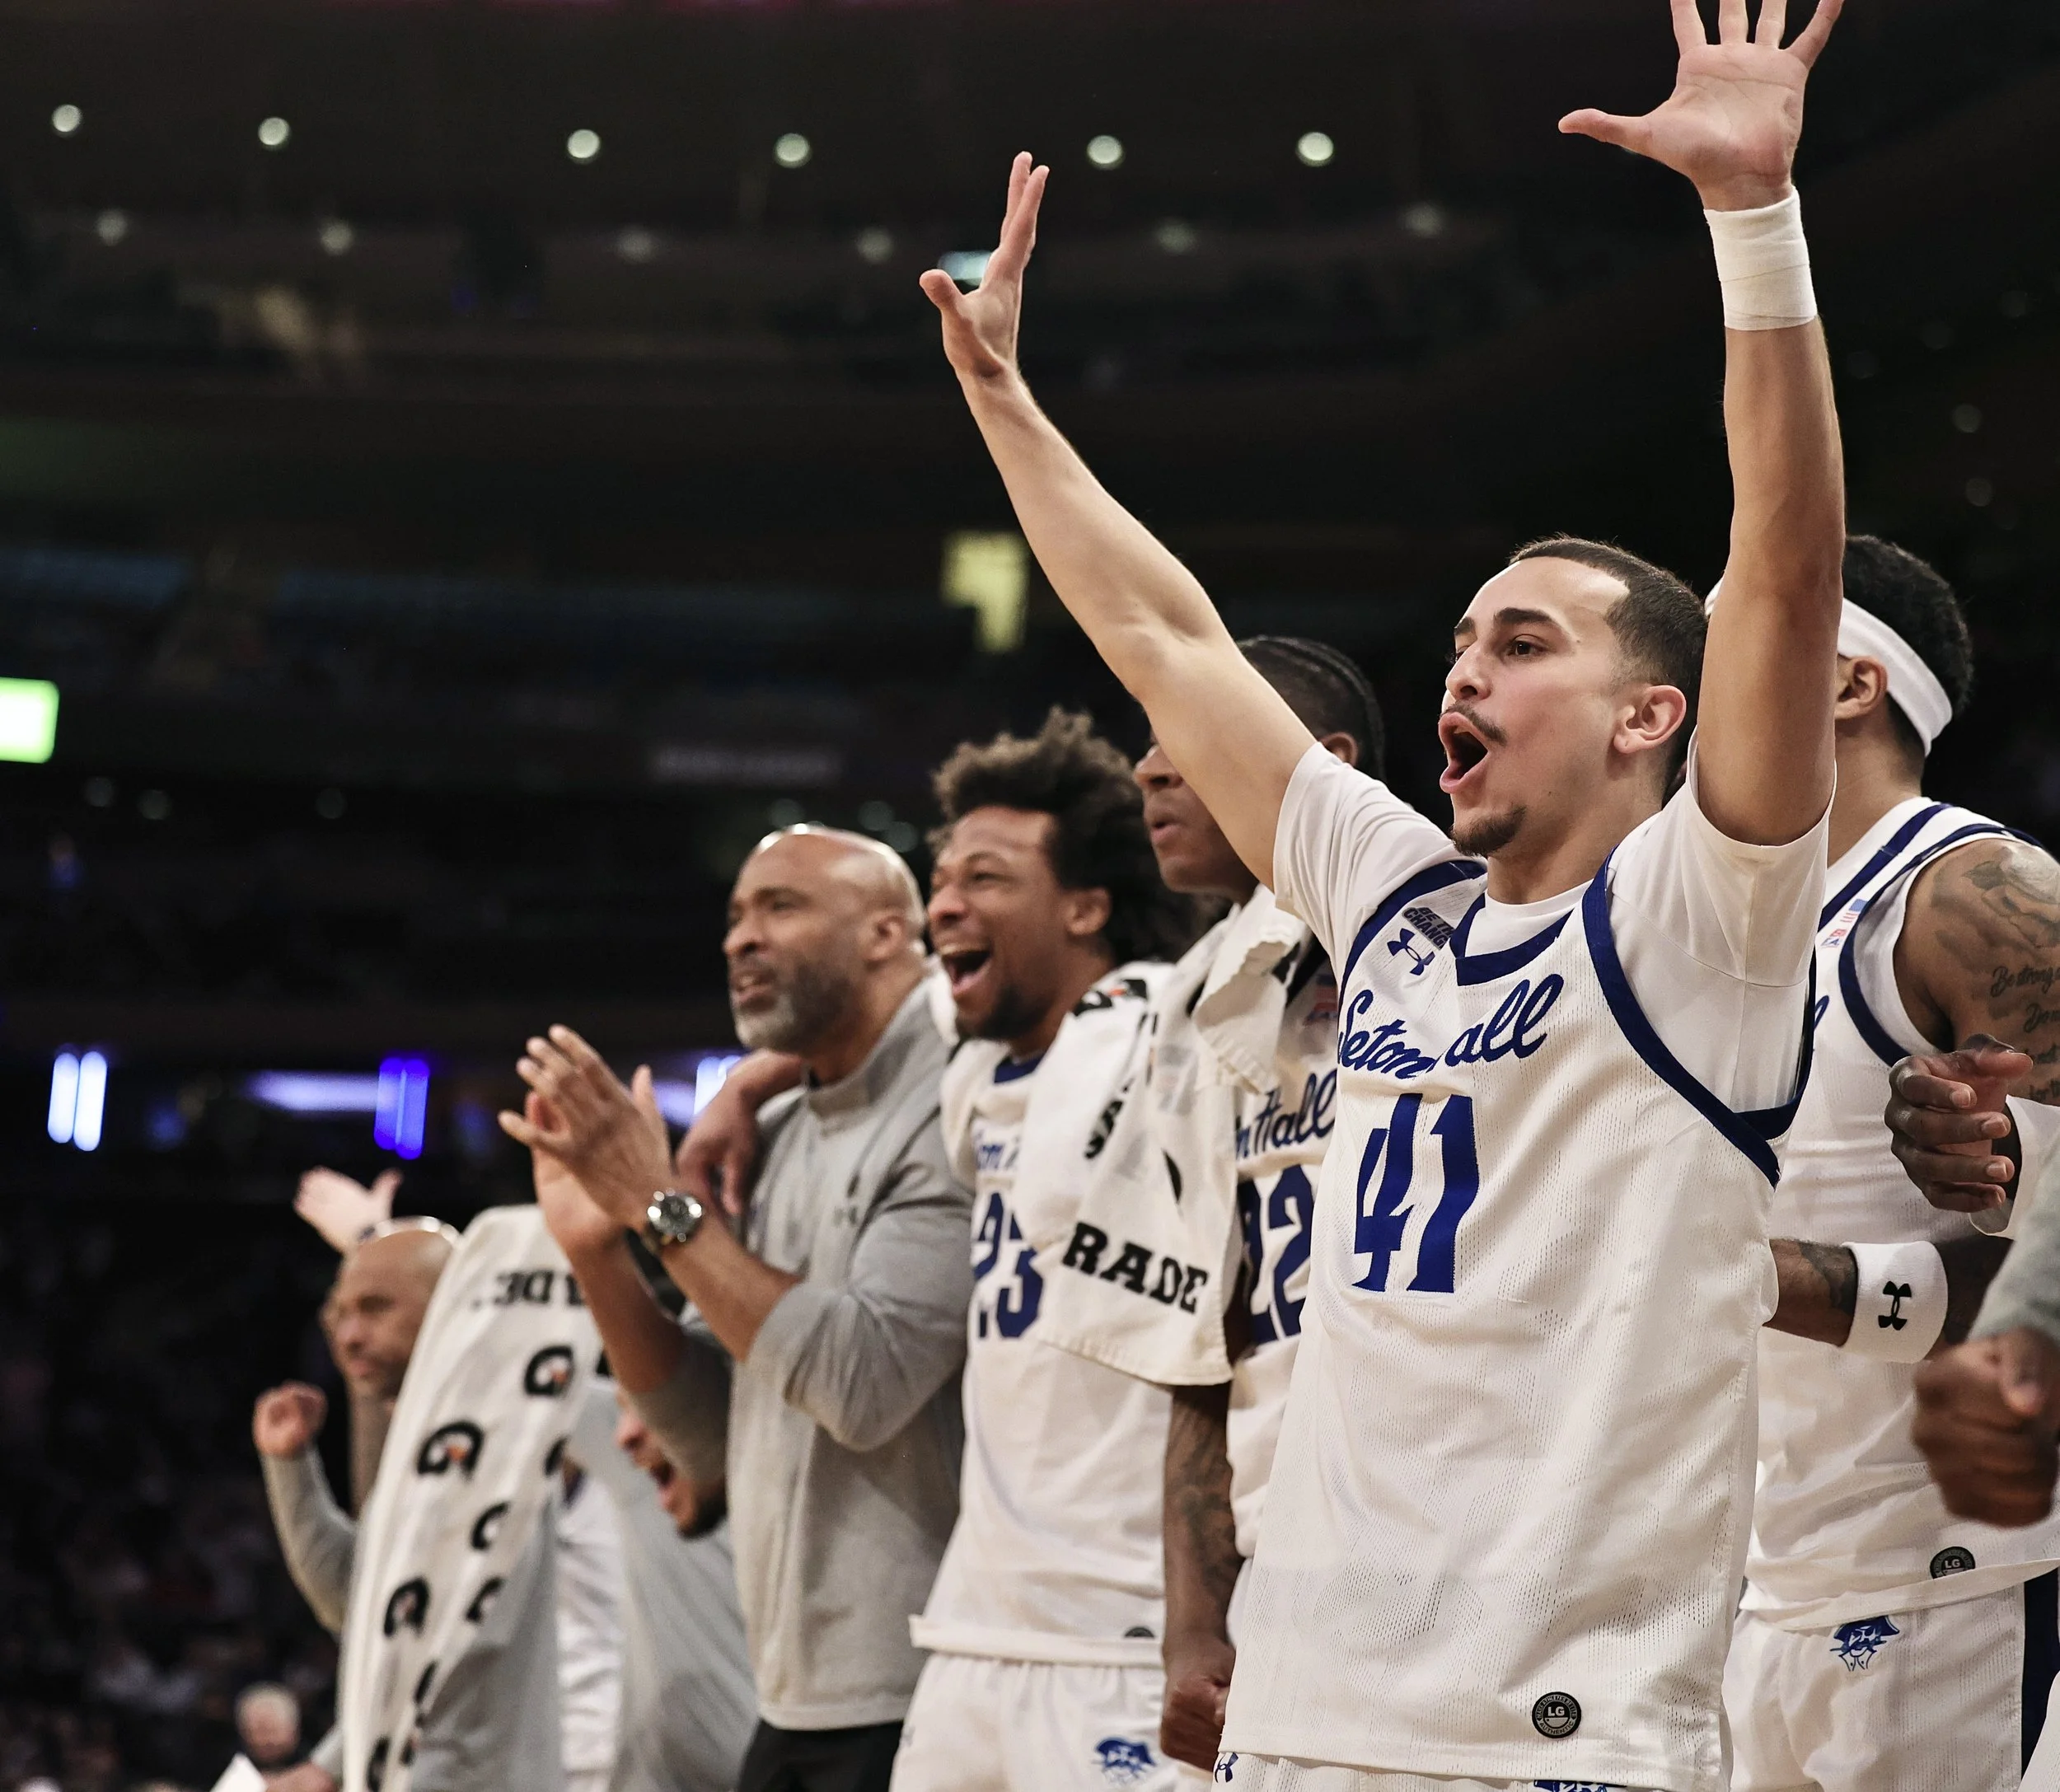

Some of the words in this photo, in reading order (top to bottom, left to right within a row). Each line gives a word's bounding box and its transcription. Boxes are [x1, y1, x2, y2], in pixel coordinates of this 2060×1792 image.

[1403, 908, 1449, 949] CHANG
[1418, 907, 1440, 922] BE
[1440, 973, 1565, 1068] all
[1352, 1093, 1480, 1294] 41
[1061, 1222, 1208, 1314] RADE
[1945, 1559, 1960, 1569] LG
[1547, 1705, 1565, 1717] LG
[1539, 1720, 1574, 1734] AUTHENTIC
